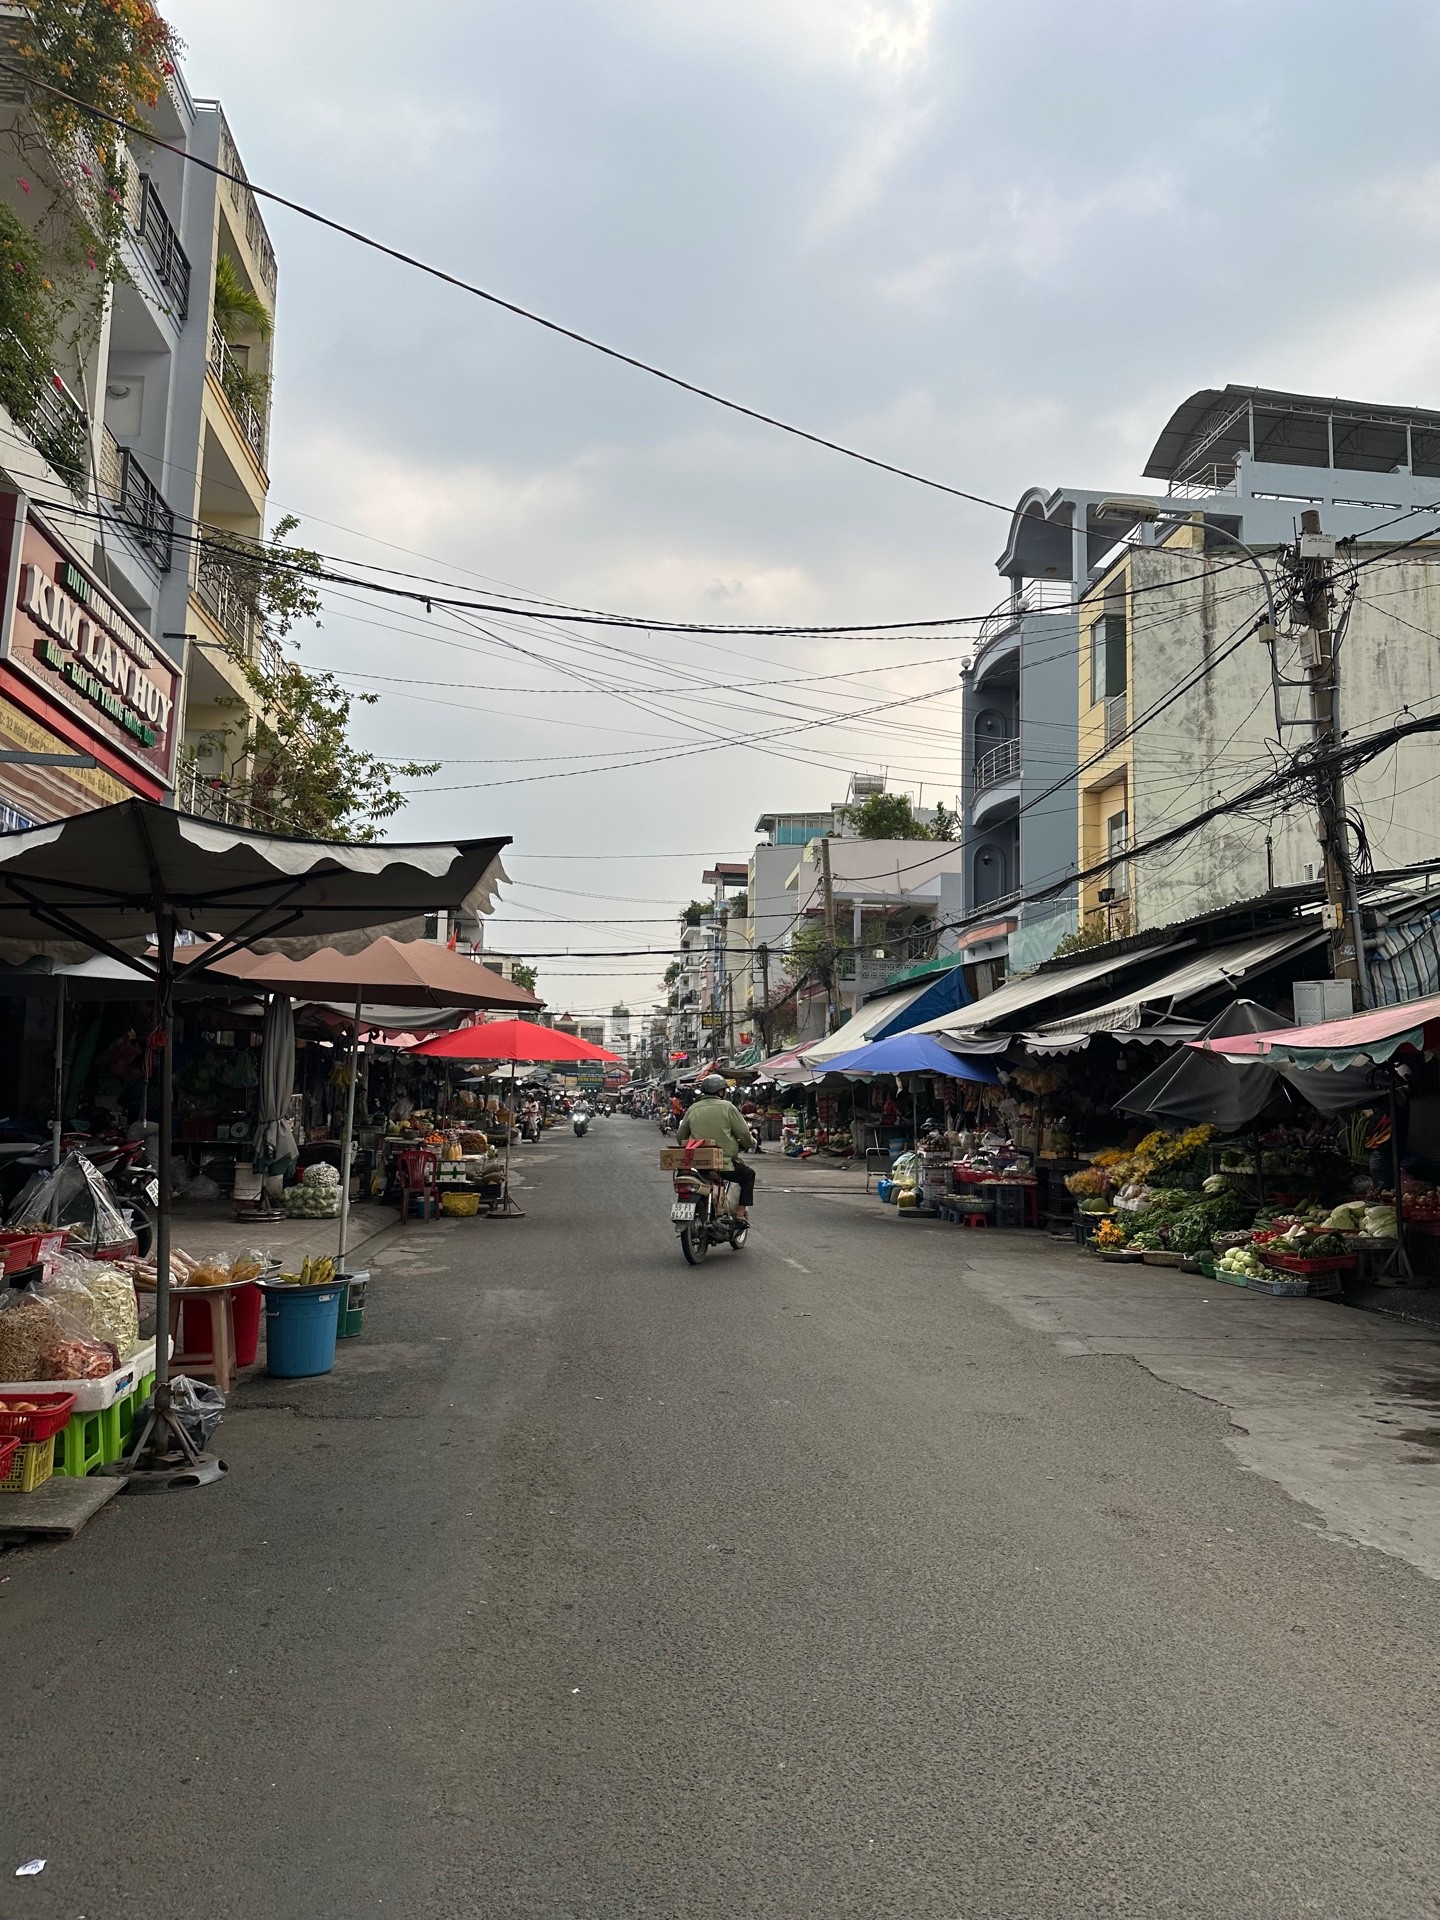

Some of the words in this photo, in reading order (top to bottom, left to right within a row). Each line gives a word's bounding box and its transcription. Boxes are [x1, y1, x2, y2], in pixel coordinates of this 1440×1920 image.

[30, 564, 82, 651] KIM
[84, 619, 131, 696] LAN
[132, 667, 173, 733] HUY
[67, 563, 91, 604] DNTN
[91, 588, 111, 626] KINH
[111, 609, 136, 651] DOANH
[46, 639, 65, 673] MUA
[71, 660, 88, 691] BÁN
[101, 688, 124, 722] TRANG
